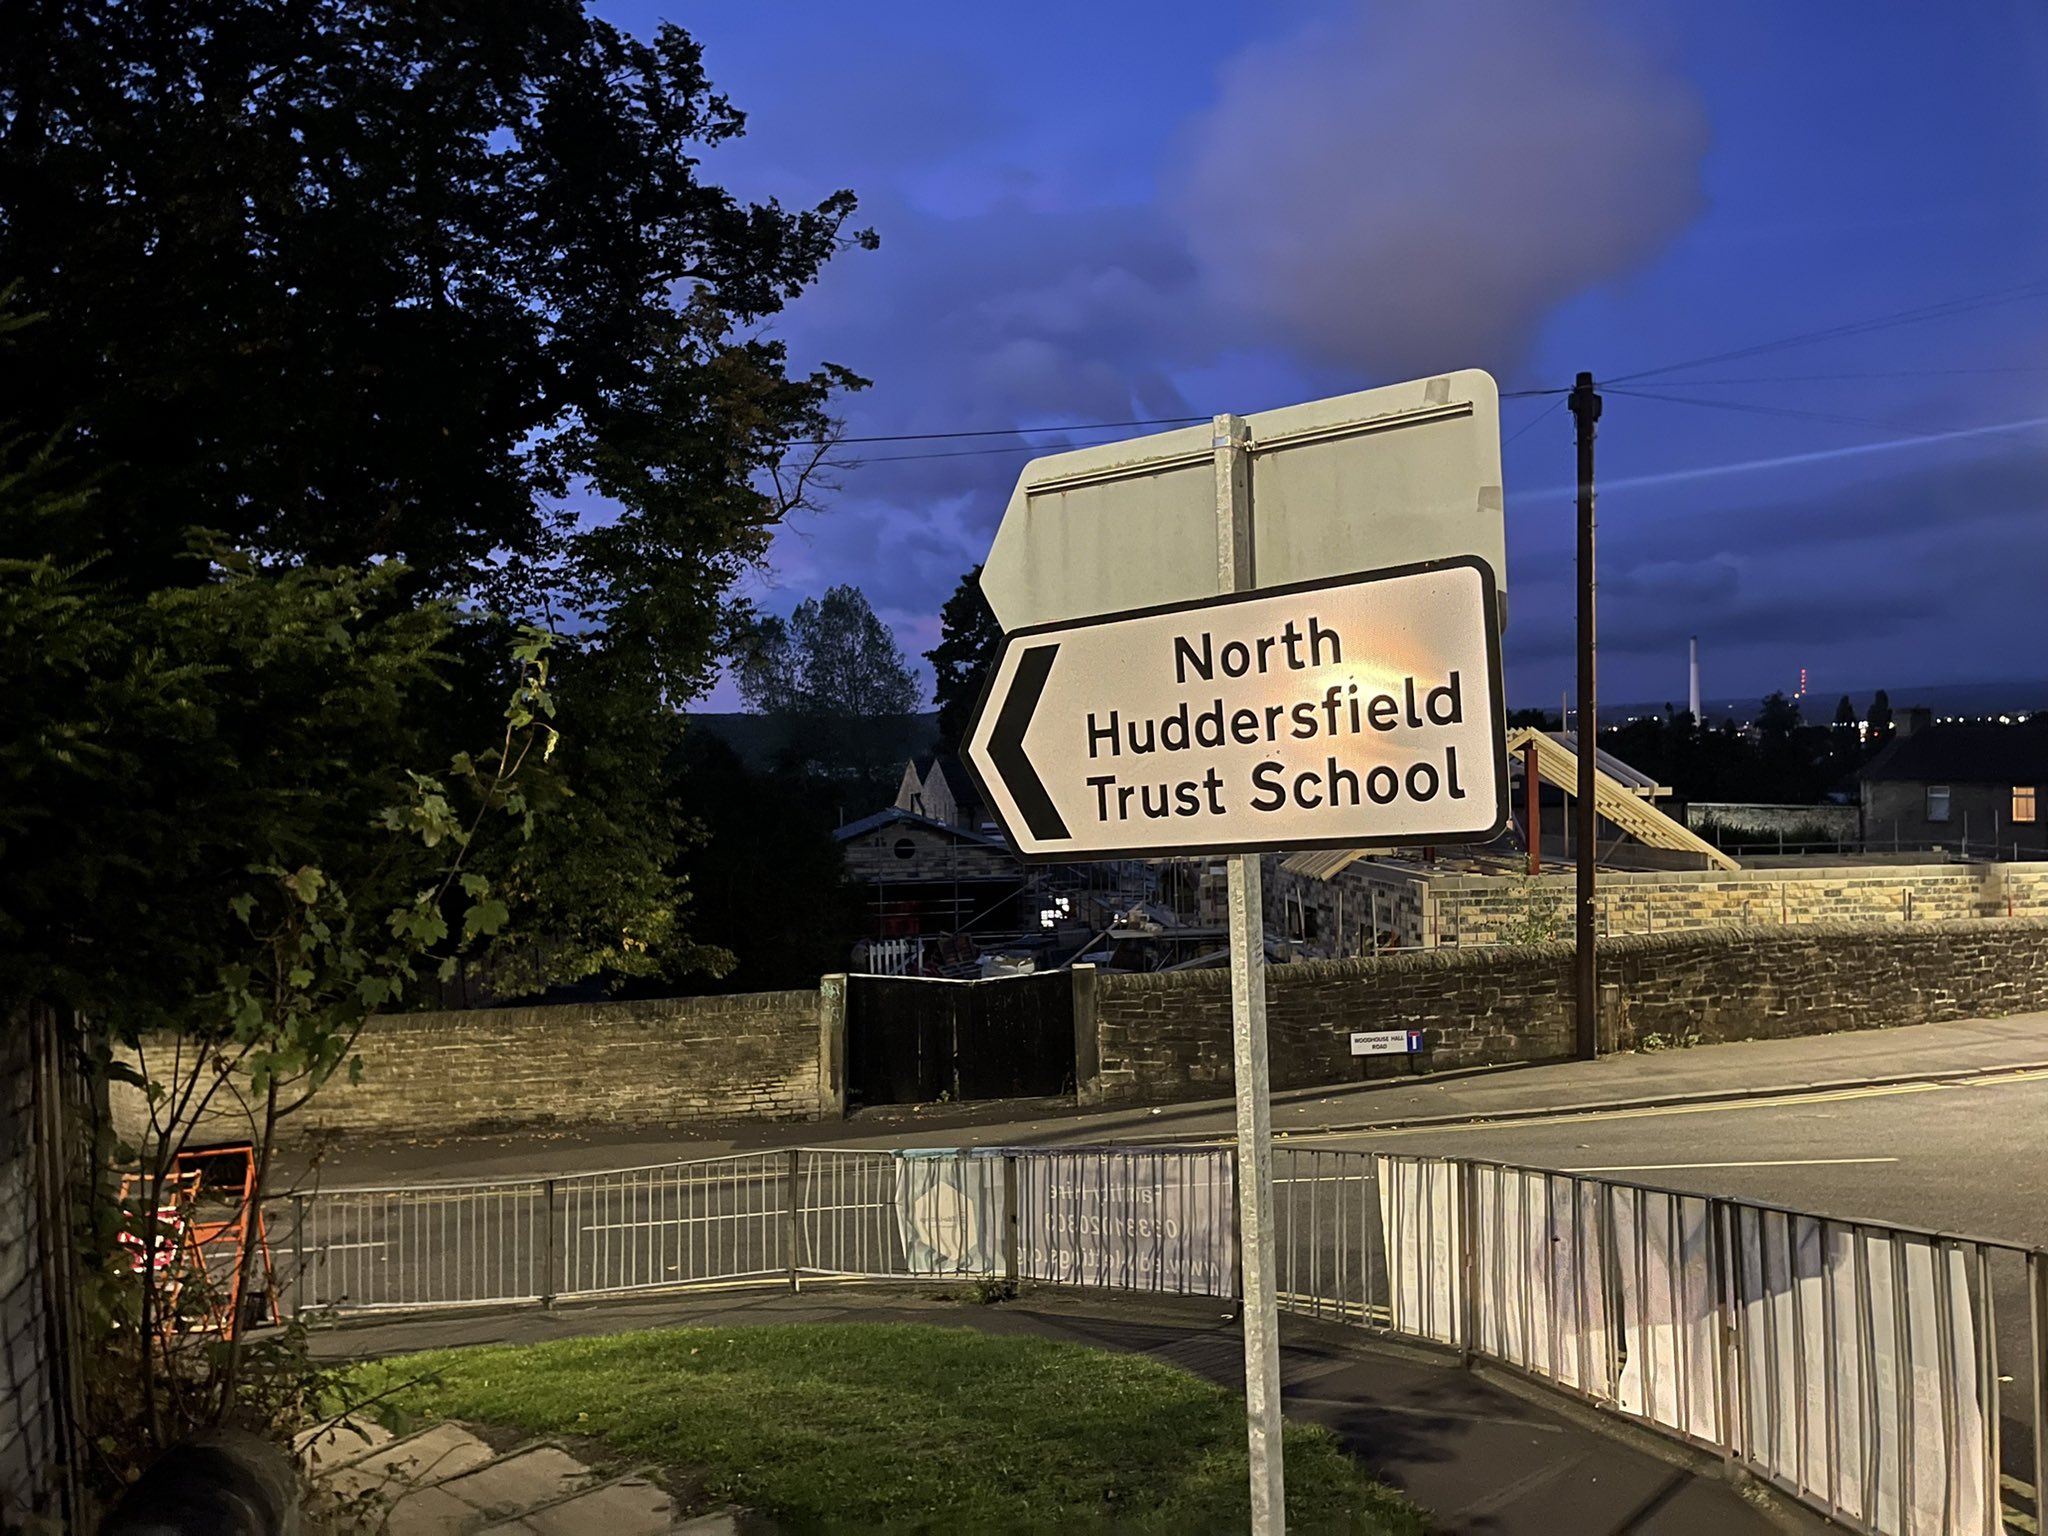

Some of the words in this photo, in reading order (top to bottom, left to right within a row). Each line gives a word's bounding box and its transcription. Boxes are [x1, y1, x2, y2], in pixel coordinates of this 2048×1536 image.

[1173, 617, 1341, 683] North
[1086, 671, 1463, 758] Huddersfield
[1086, 767, 1227, 821] Trust
[1250, 746, 1466, 812] School
